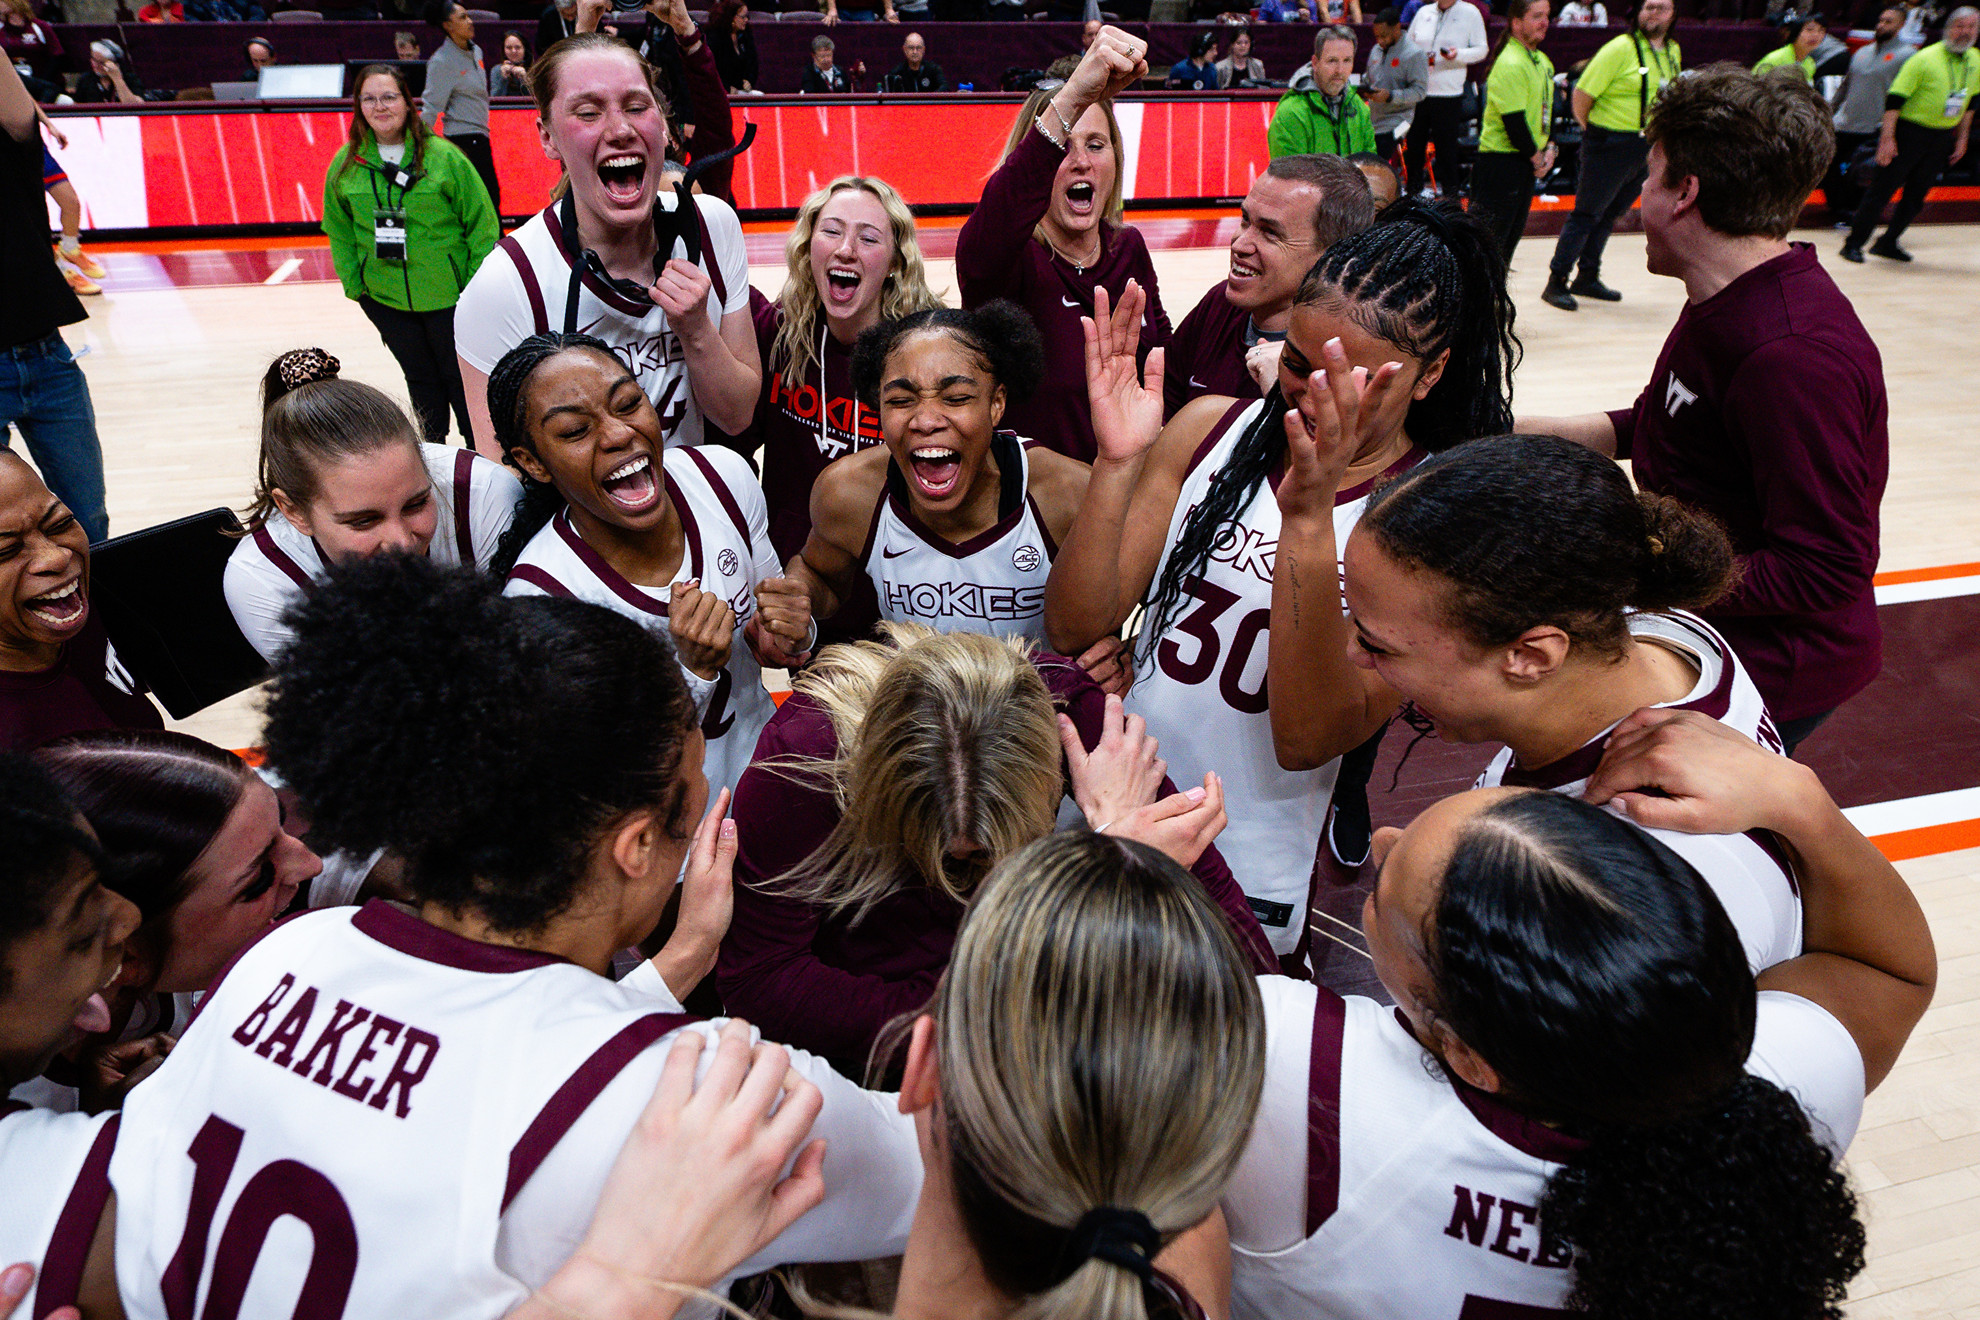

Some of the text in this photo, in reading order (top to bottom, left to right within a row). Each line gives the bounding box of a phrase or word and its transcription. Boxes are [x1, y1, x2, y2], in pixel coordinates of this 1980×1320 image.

[770, 372, 884, 439] HOKIE
[1665, 370, 1698, 418] VT
[839, 431, 874, 445] VIRGNIA
[883, 580, 1045, 621] HOKIES
[1157, 574, 1271, 714] 30
[231, 972, 440, 1119] BAKER
[160, 1112, 359, 1320] 10
